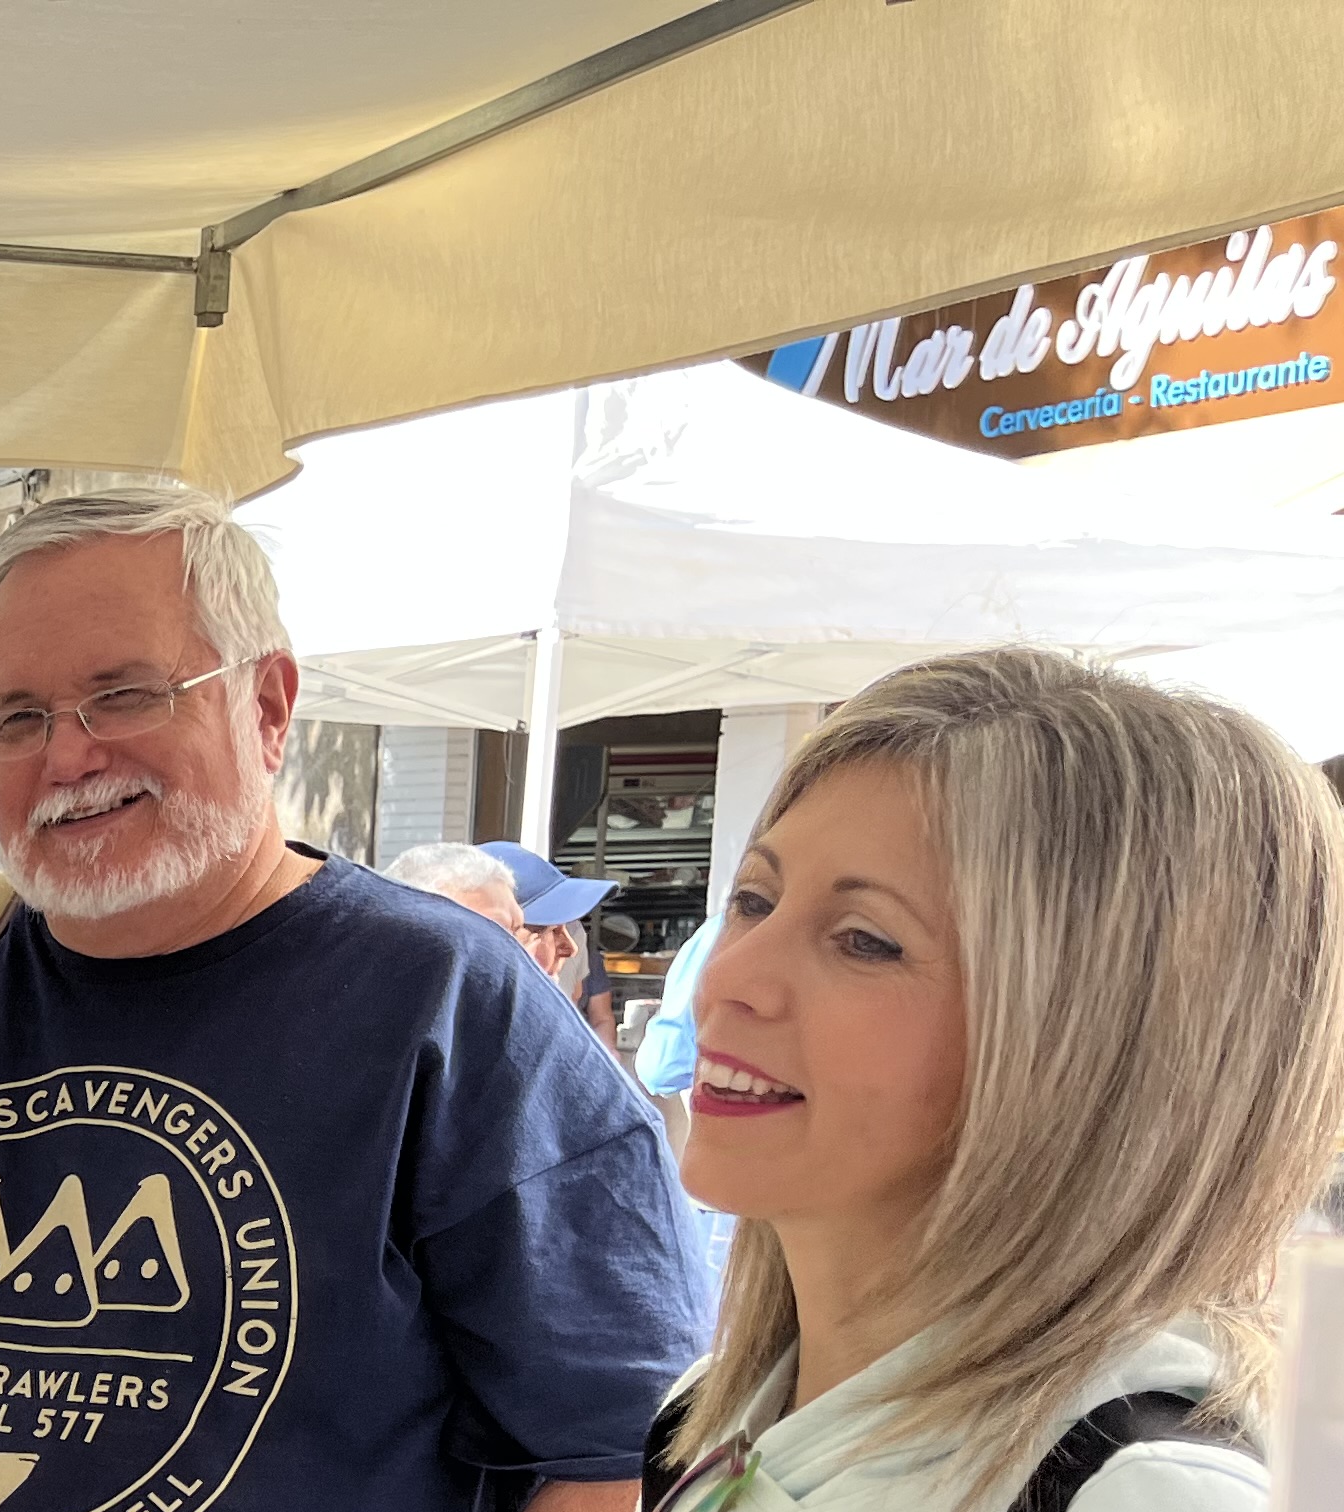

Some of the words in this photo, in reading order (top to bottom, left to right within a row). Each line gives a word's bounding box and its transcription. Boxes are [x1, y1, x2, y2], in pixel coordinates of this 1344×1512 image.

[844, 316, 974, 404] Mar
[980, 284, 1052, 381] de
[980, 385, 1123, 439] Cervecería
[1150, 350, 1331, 409] Restaurante
[223, 1217, 280, 1398] UNION
[32, 1408, 104, 1444] 577
